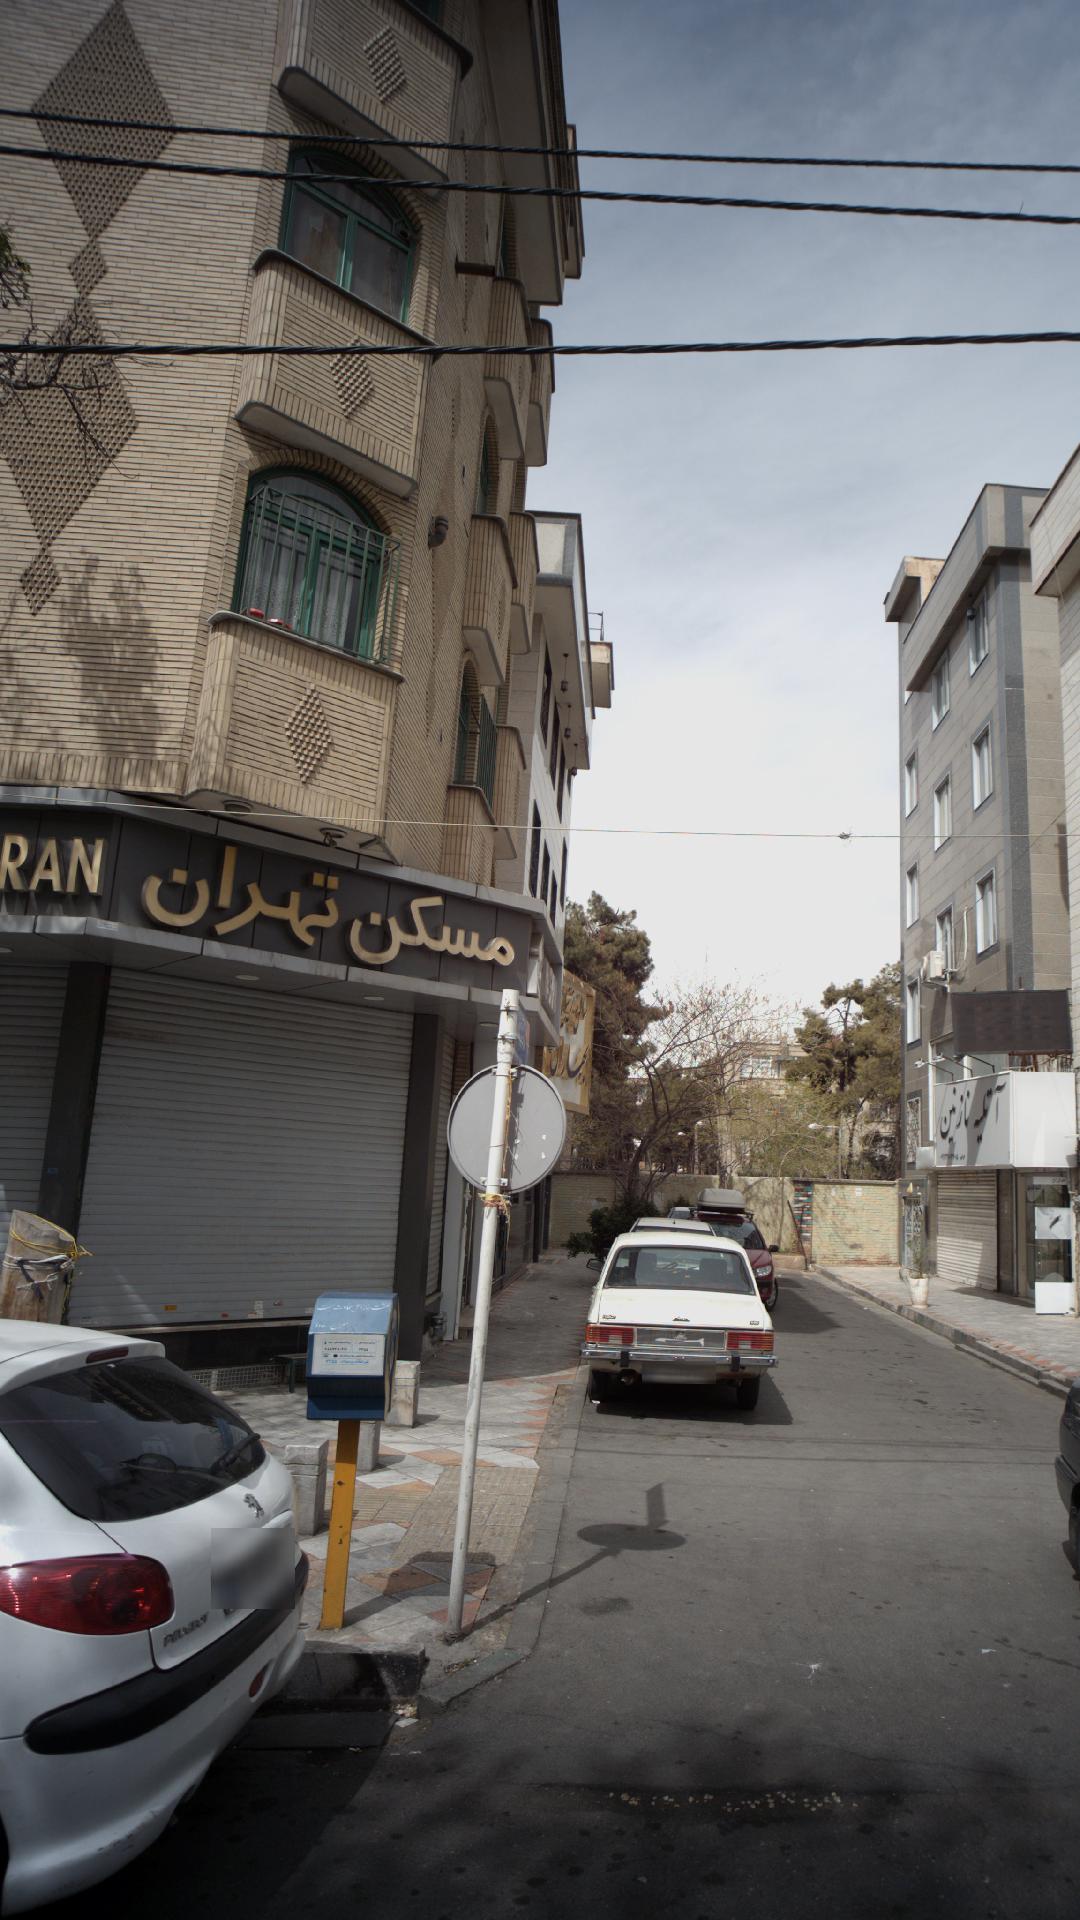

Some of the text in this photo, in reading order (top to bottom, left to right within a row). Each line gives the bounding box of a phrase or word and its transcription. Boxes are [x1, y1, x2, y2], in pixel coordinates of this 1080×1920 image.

[0, 833, 105, 895] RAN
[141, 844, 515, 967] مسکن تهران
